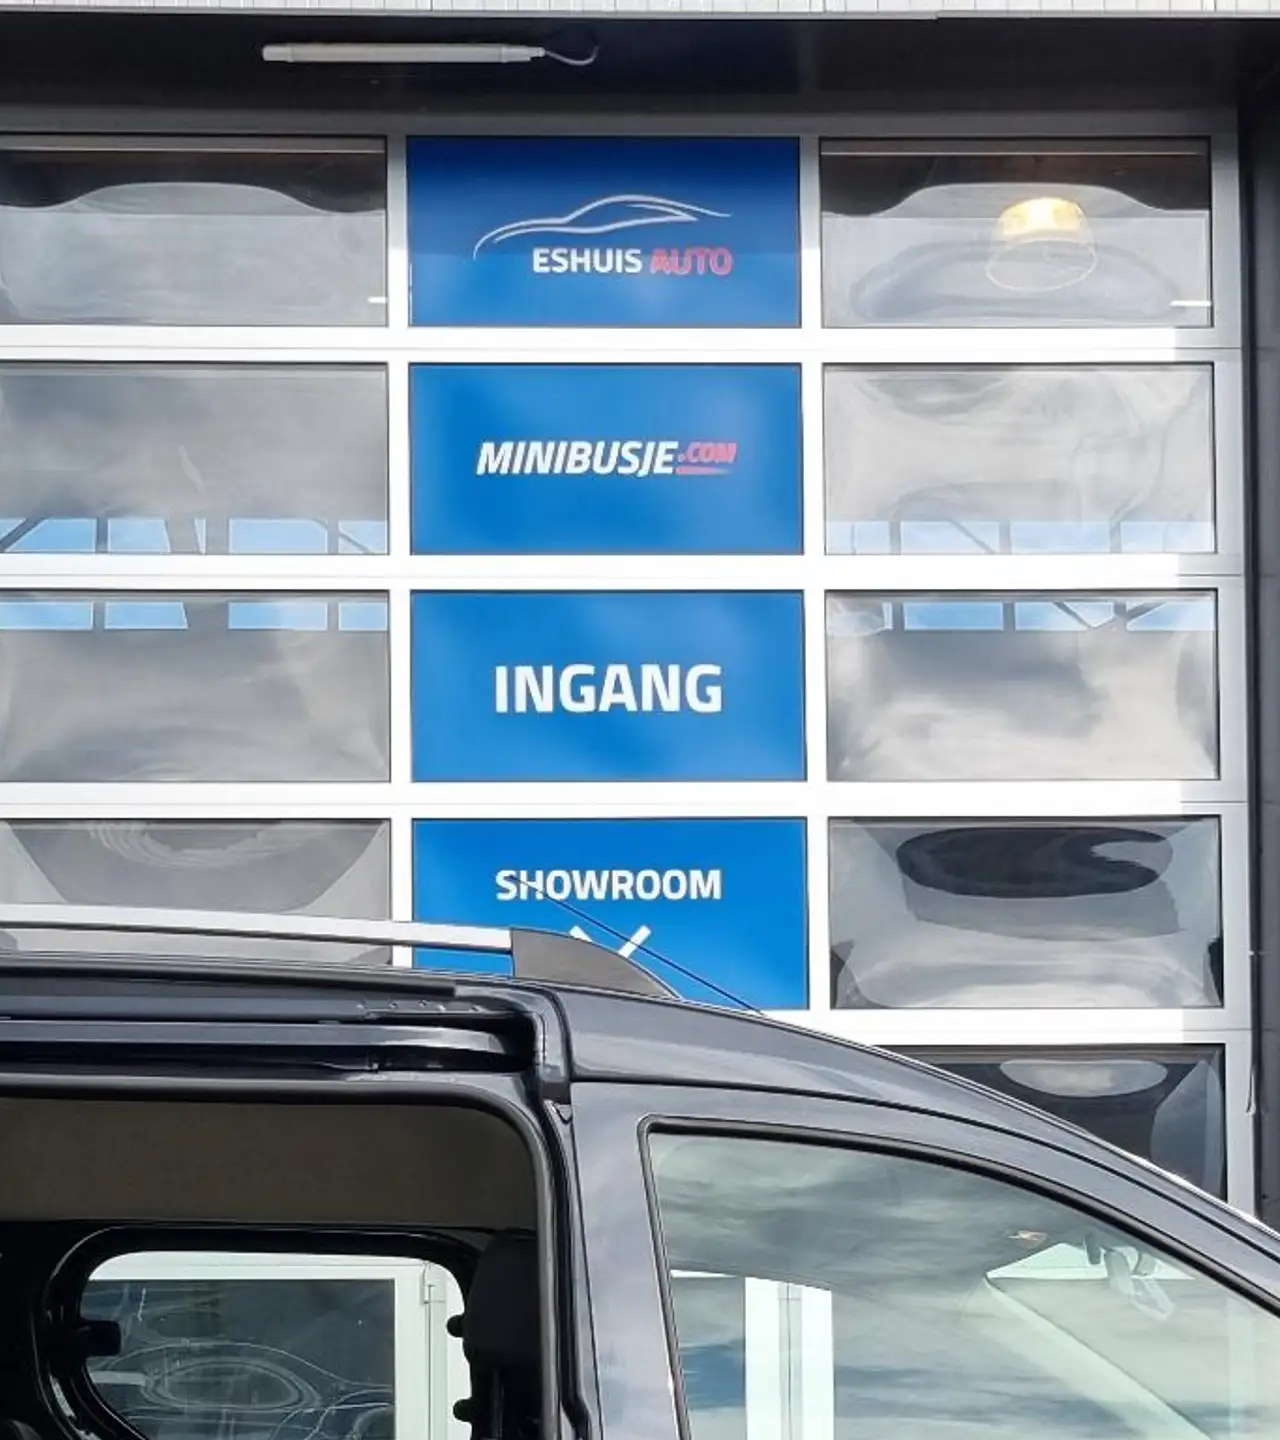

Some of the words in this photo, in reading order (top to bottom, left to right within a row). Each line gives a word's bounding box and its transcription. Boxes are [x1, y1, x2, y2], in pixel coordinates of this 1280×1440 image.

[532, 247, 642, 274] ESHUIS
[649, 247, 733, 275] AUTO
[495, 663, 722, 713] INGANG
[495, 869, 721, 901] SHOWROOM
